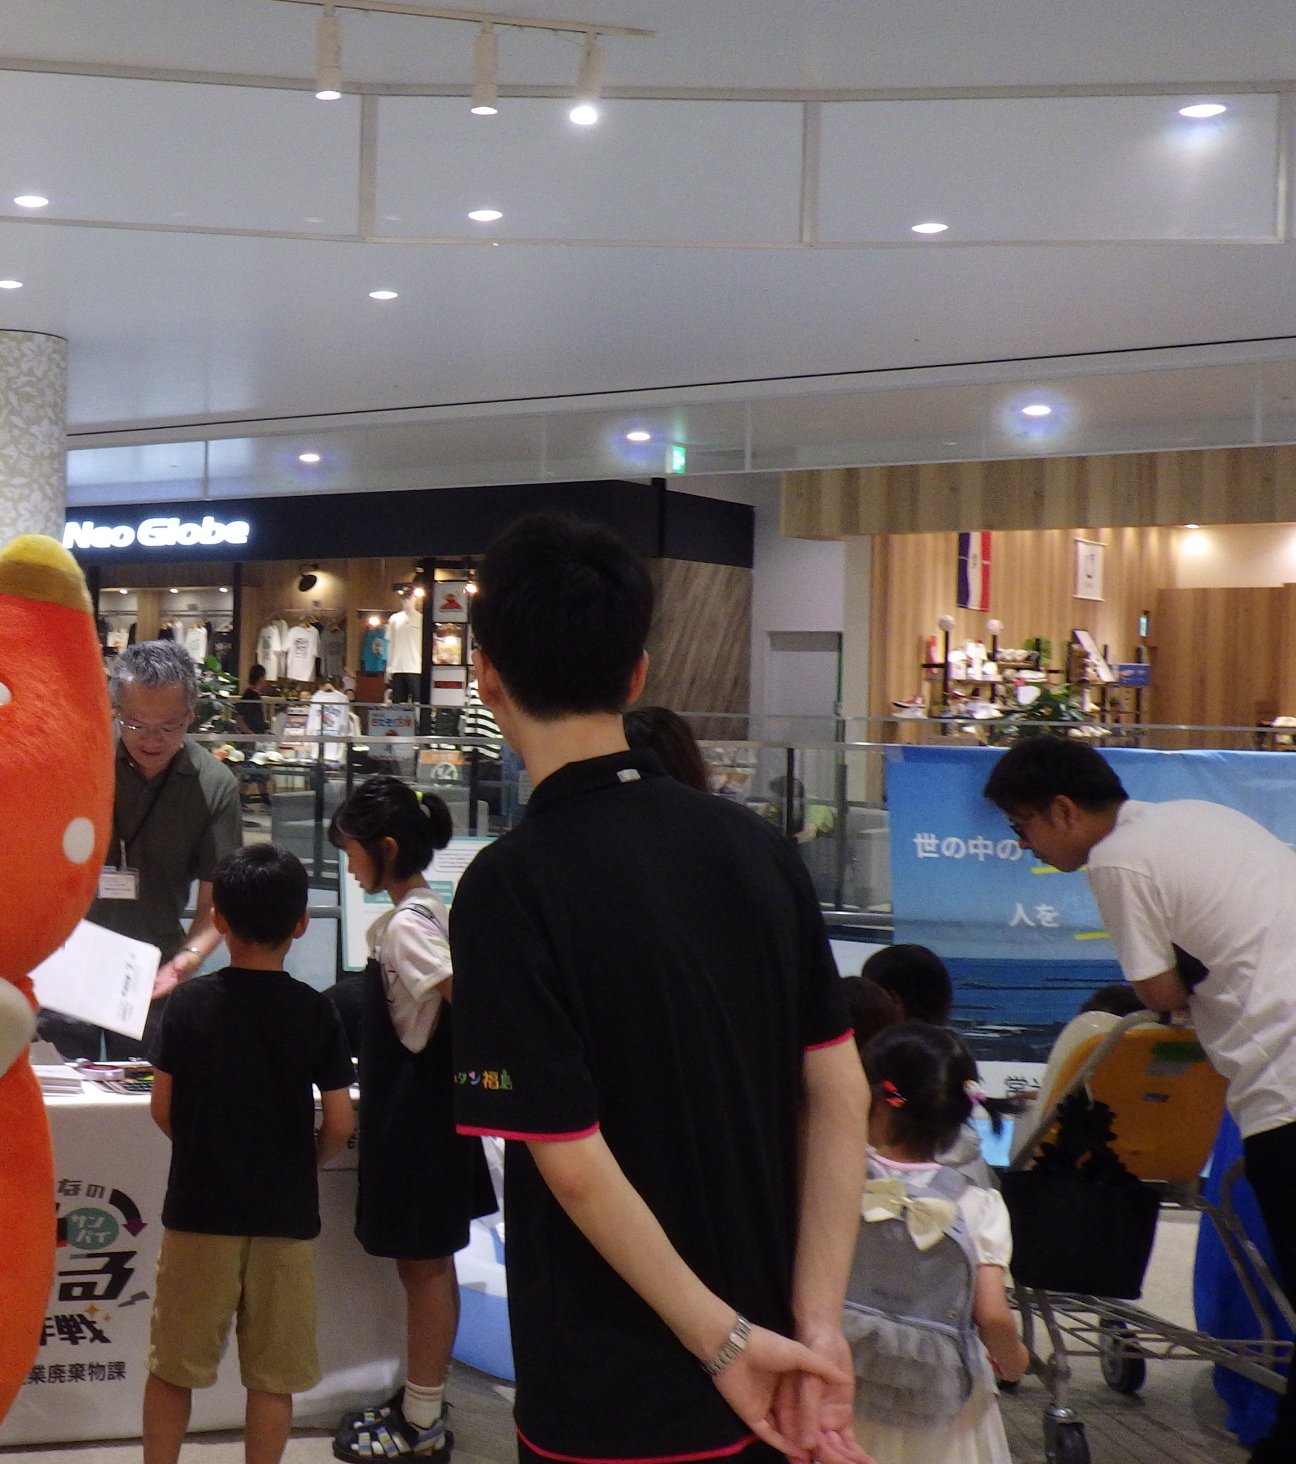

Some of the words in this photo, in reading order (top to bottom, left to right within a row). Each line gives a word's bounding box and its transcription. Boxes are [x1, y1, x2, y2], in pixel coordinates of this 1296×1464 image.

[62, 521, 135, 549] Neo
[137, 516, 250, 546] Globe
[913, 832, 1023, 862] 世の中の
[1008, 903, 1059, 928] 人を
[21, 1360, 127, 1386] 業廃棄物課
